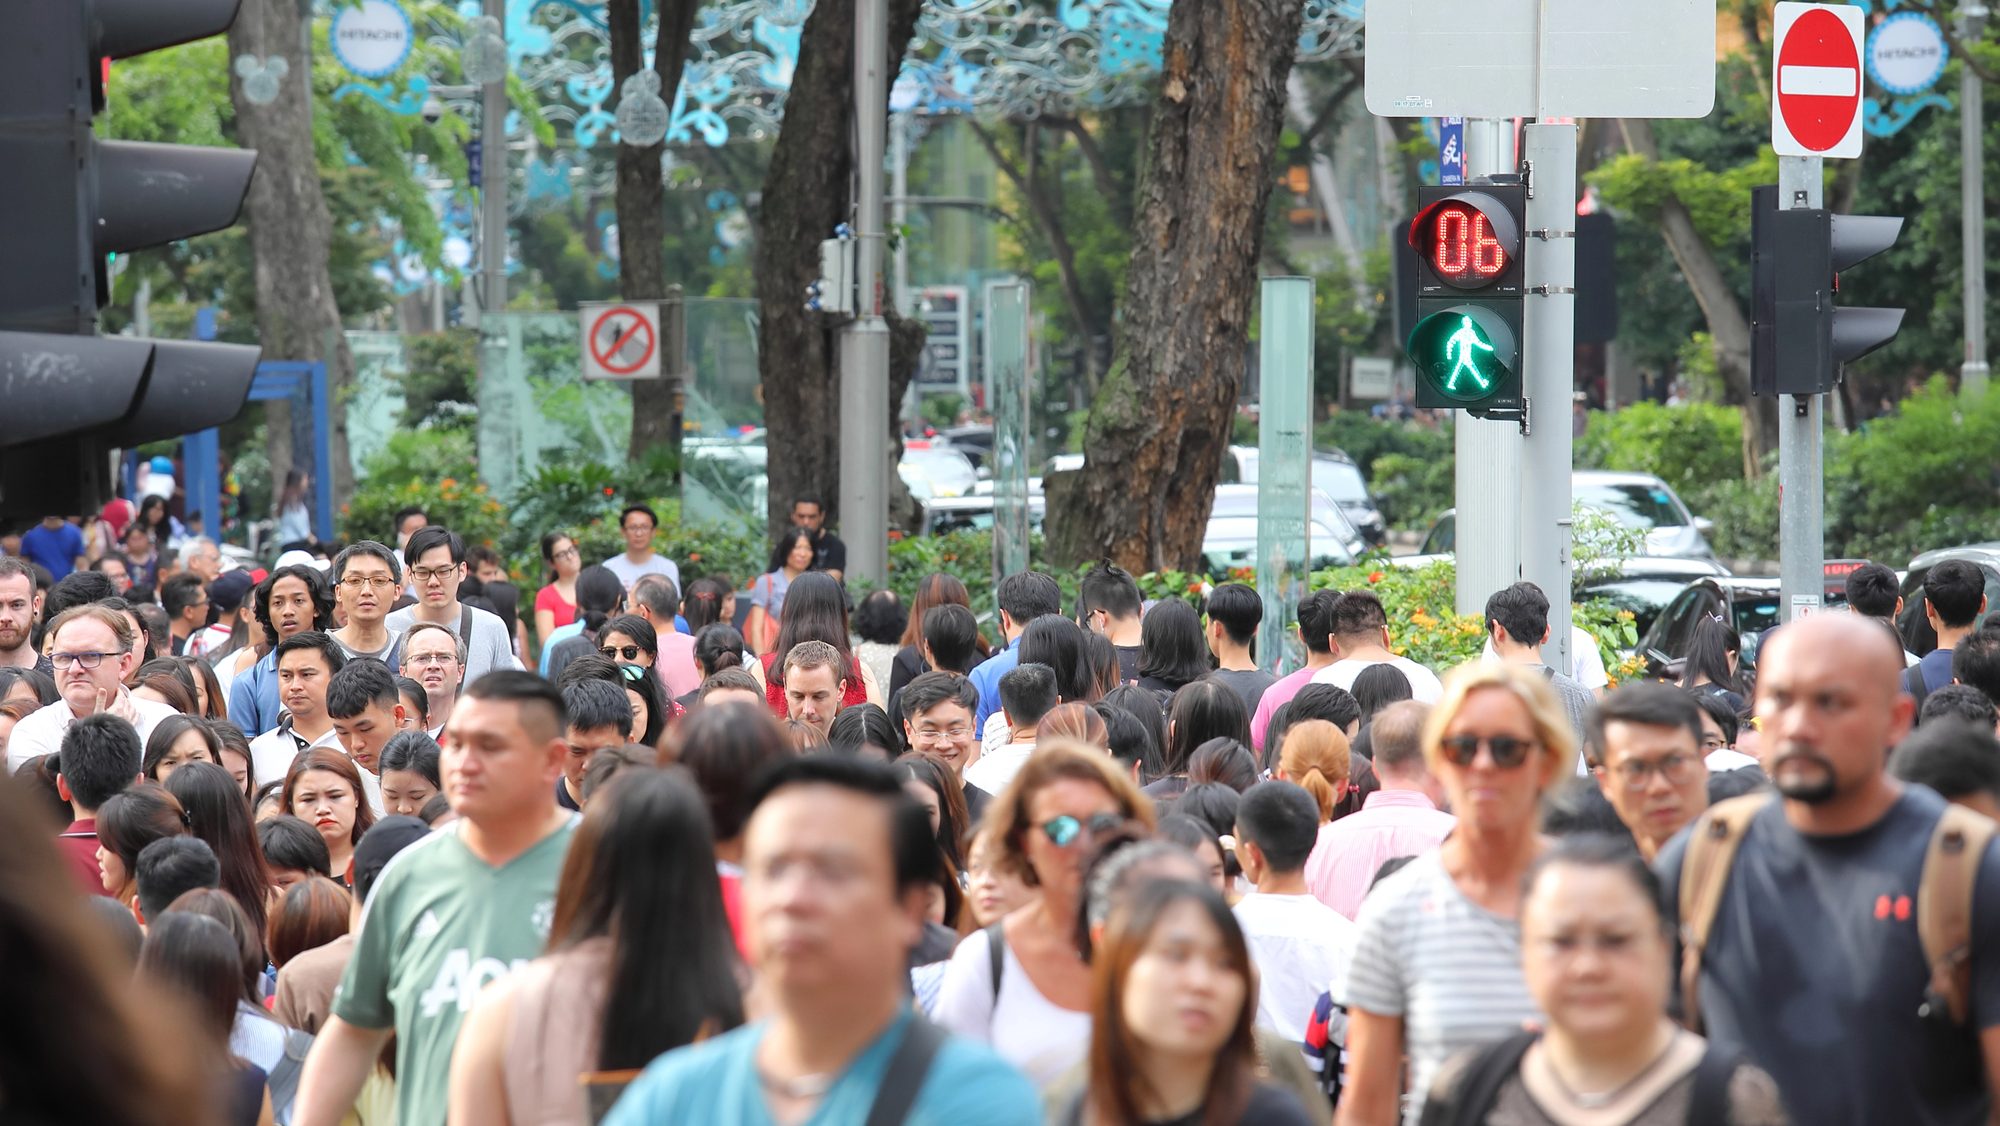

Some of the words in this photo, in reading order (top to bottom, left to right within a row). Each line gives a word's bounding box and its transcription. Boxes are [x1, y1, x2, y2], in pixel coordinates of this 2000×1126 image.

[340, 27, 403, 40] HITACHI
[1877, 46, 1938, 60] HITACHI
[1440, 211, 1503, 272] 06
